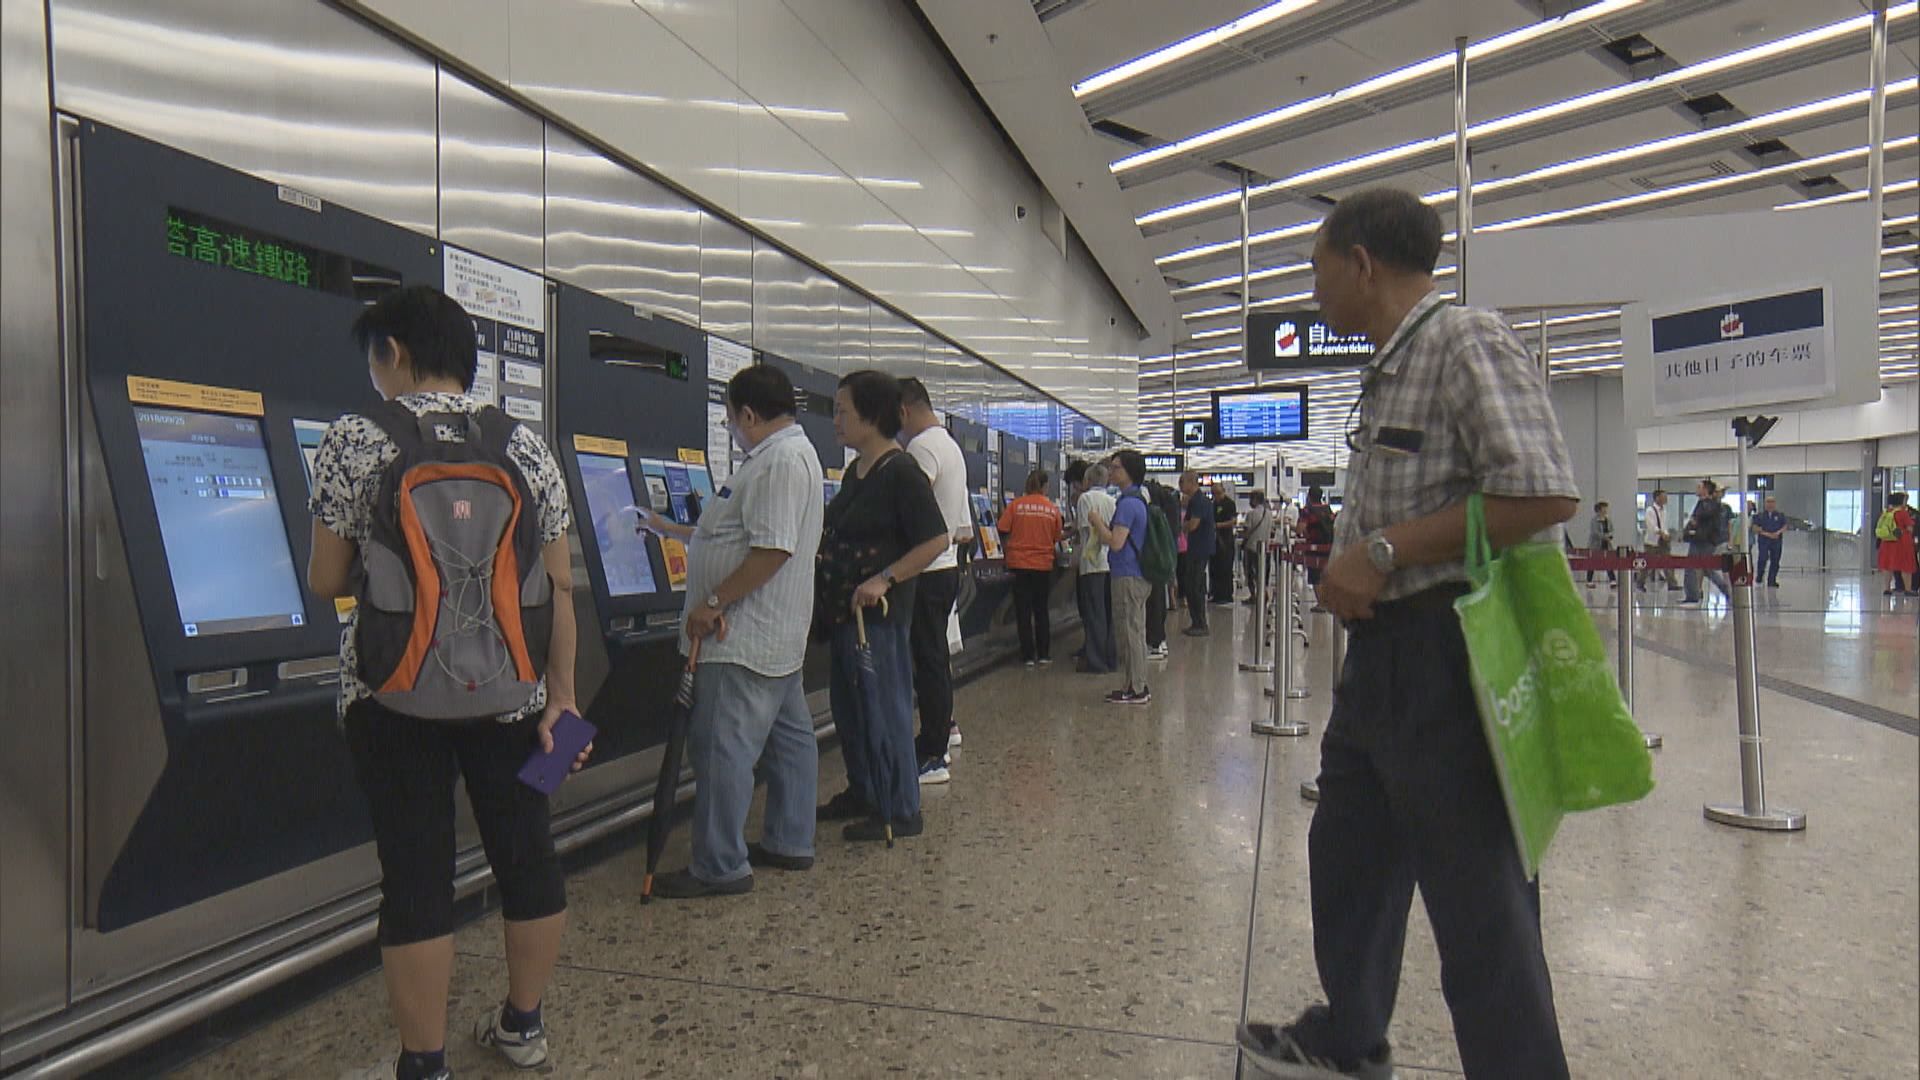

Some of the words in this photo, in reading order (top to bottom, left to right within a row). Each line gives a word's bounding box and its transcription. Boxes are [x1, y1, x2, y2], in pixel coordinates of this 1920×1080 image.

[1309, 343, 1349, 355] Self-service
[1349, 342, 1369, 353] ticket
[1665, 342, 1811, 379] 其他日子的车票
